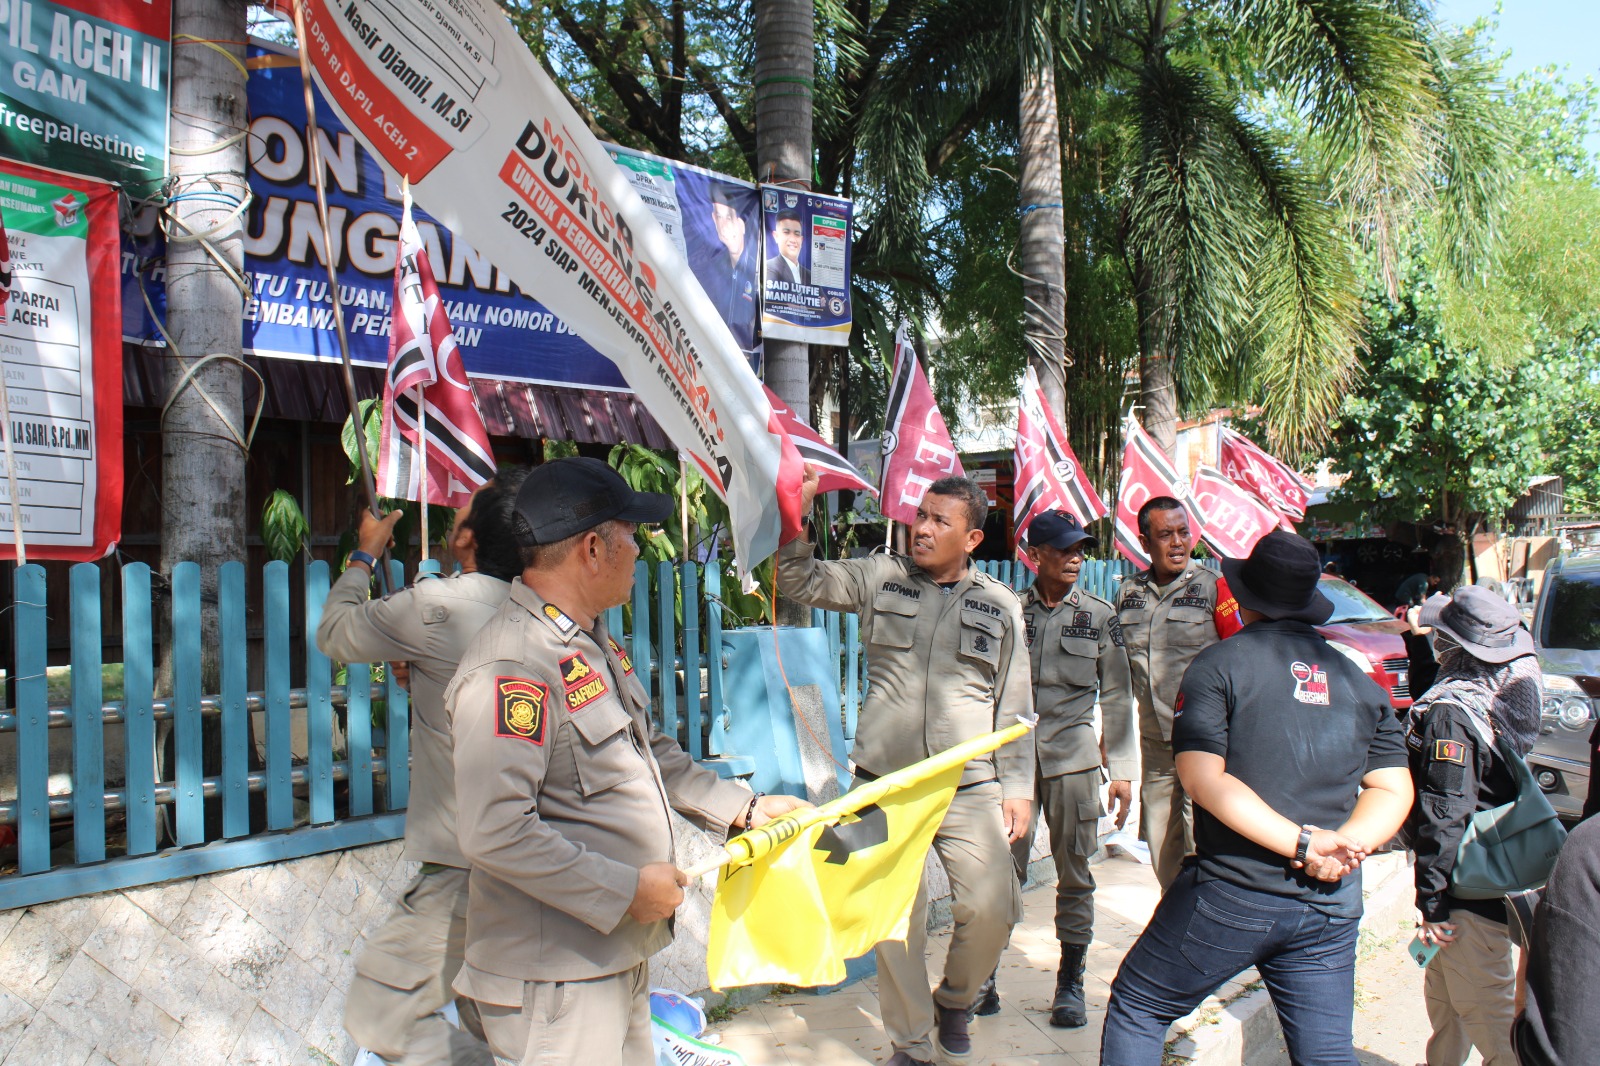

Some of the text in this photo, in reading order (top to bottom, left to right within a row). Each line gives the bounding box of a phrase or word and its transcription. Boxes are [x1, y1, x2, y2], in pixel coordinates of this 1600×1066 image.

[50, 12, 133, 82] ACEH
[142, 42, 161, 92] II
[463, 41, 482, 64] M.Si
[344, 3, 382, 51] Nasir
[377, 43, 433, 105] Djamil,
[431, 92, 473, 133] M.Si
[13, 61, 87, 105] GAM
[311, 21, 330, 57] DPR
[328, 53, 343, 74] RI
[340, 70, 374, 116] DAPIL
[373, 113, 409, 150] ACEH
[404, 145, 419, 161] 2
[12, 182, 37, 198] UMUM
[807, 198, 813, 207] 5
[512, 162, 560, 222] UNTUK
[556, 212, 639, 315] PERUBAHAN,
[501, 202, 548, 247] 2024
[544, 238, 579, 275] SIAP
[578, 270, 657, 365] MENJEMPUT
[766, 280, 820, 297] SAID LUTFIE
[10, 289, 60, 312] PARTAI
[296, 278, 392, 316] TUJUAN,
[484, 305, 554, 333] NOMOR
[765, 290, 821, 308] MANFALUTIE
[833, 301, 841, 312] 5
[12, 308, 49, 329] ACEH
[26, 422, 50, 448] SARI,
[881, 581, 921, 600] RIDWAN
[964, 599, 1001, 617] POLISI PP
[1064, 628, 1098, 639] POLISI-PP
[567, 676, 606, 708] SAFRIZAL
